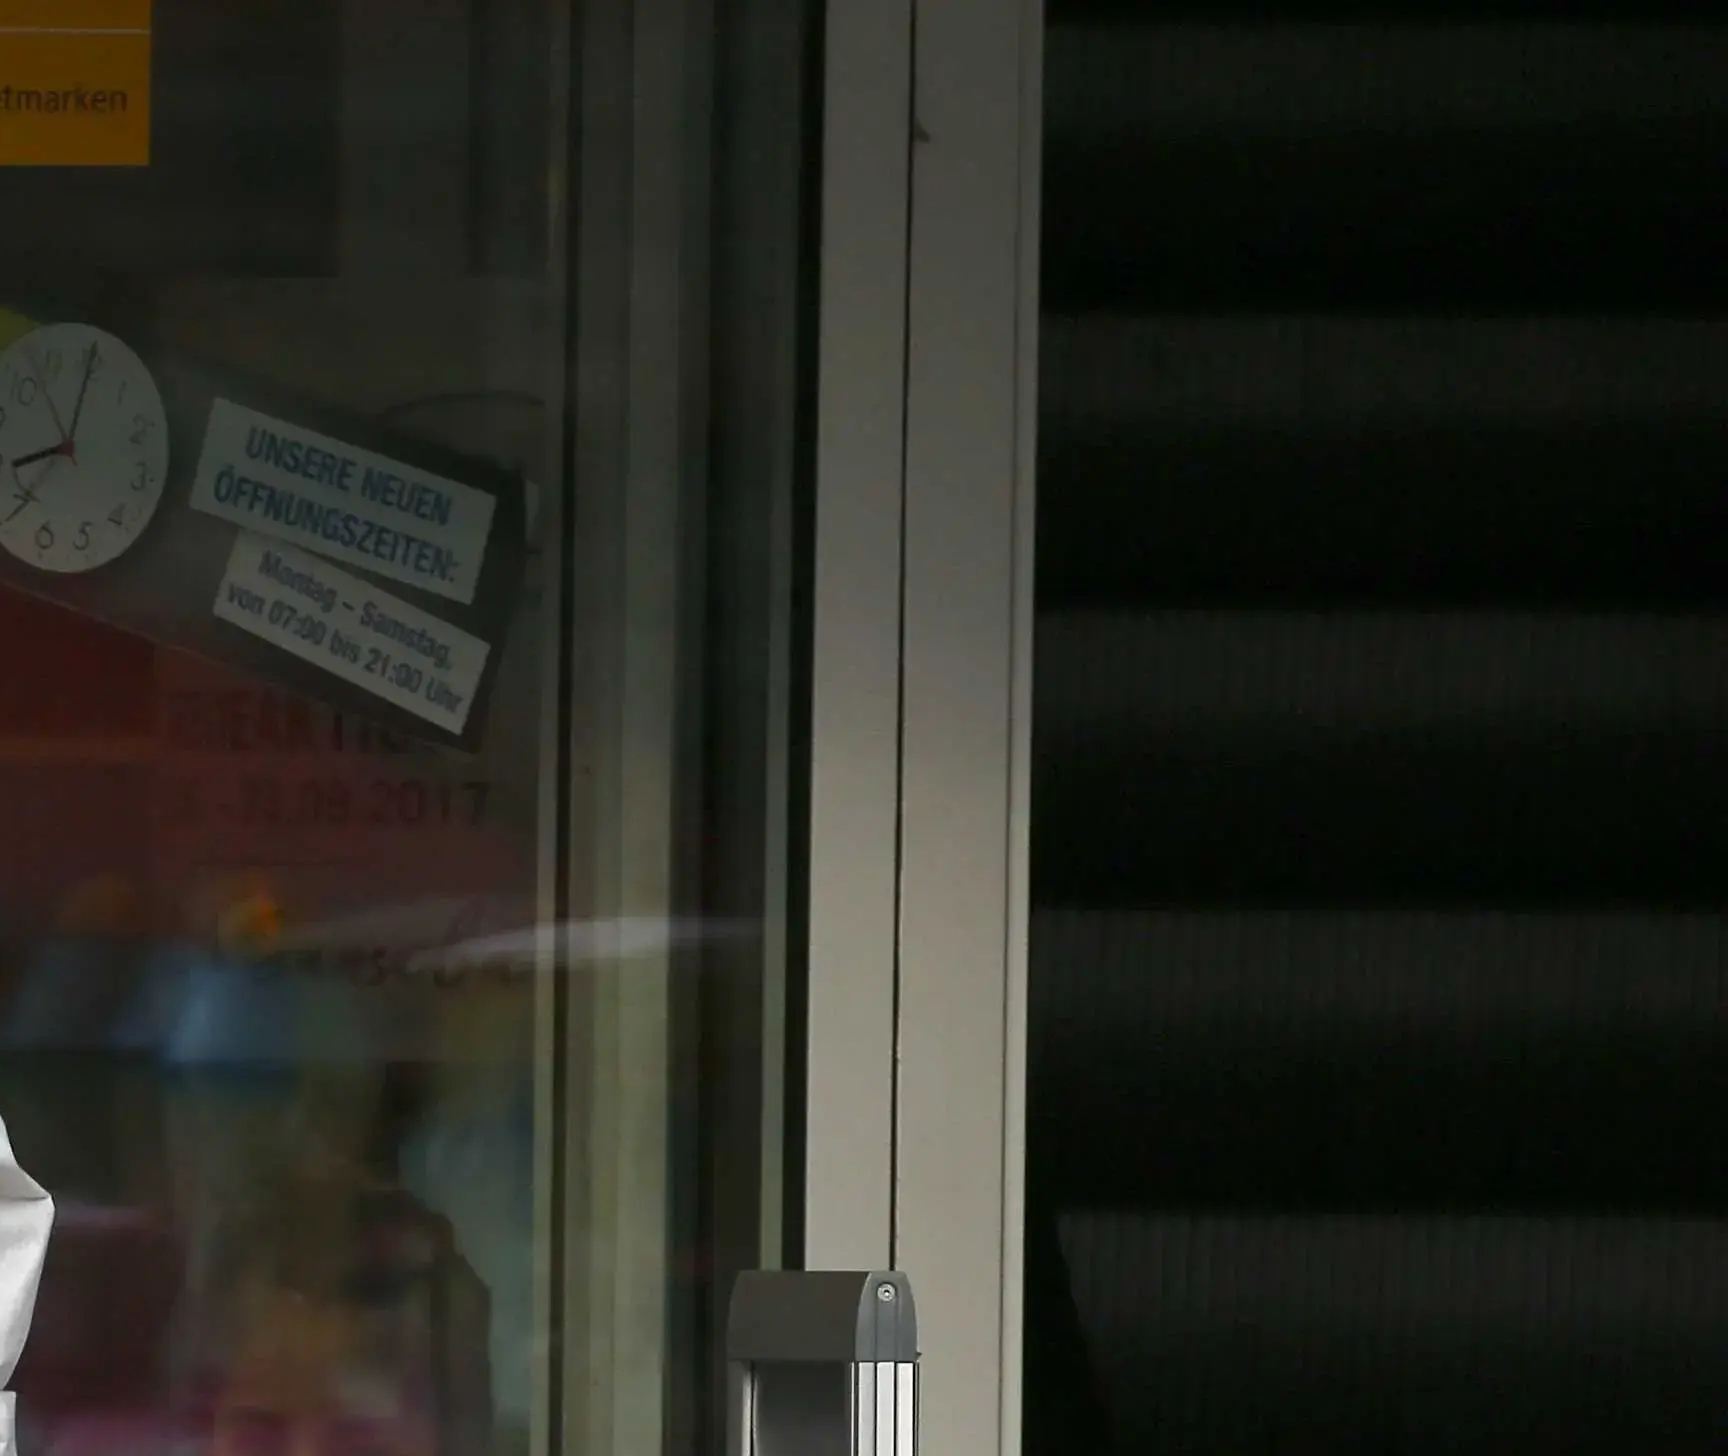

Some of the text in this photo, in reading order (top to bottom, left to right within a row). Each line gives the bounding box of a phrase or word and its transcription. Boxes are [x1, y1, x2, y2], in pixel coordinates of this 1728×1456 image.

[245, 424, 454, 527] UNSERE NEUEN
[258, 548, 338, 614] Montag
[226, 583, 465, 714] von 07:00 bis 21:00 Uhr
